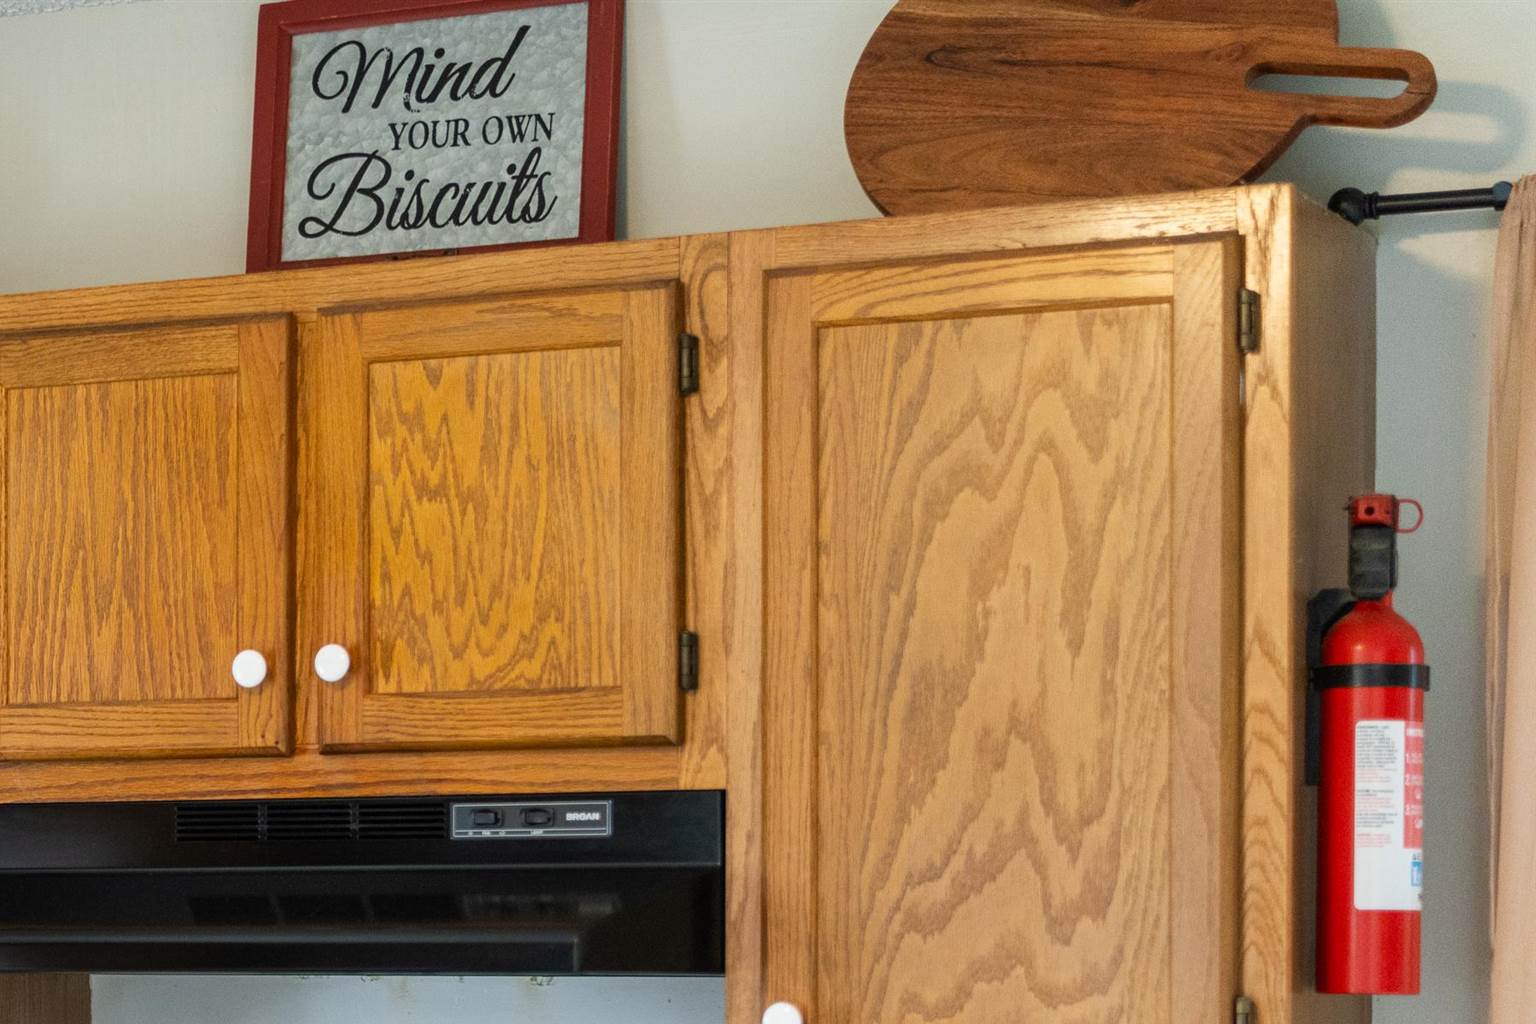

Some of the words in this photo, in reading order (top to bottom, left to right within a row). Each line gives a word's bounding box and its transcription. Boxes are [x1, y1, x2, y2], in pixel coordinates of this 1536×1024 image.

[312, 25, 531, 114] Mind
[388, 118, 471, 151] YOUR
[482, 112, 556, 146] OWN
[298, 147, 558, 239] Biscuits
